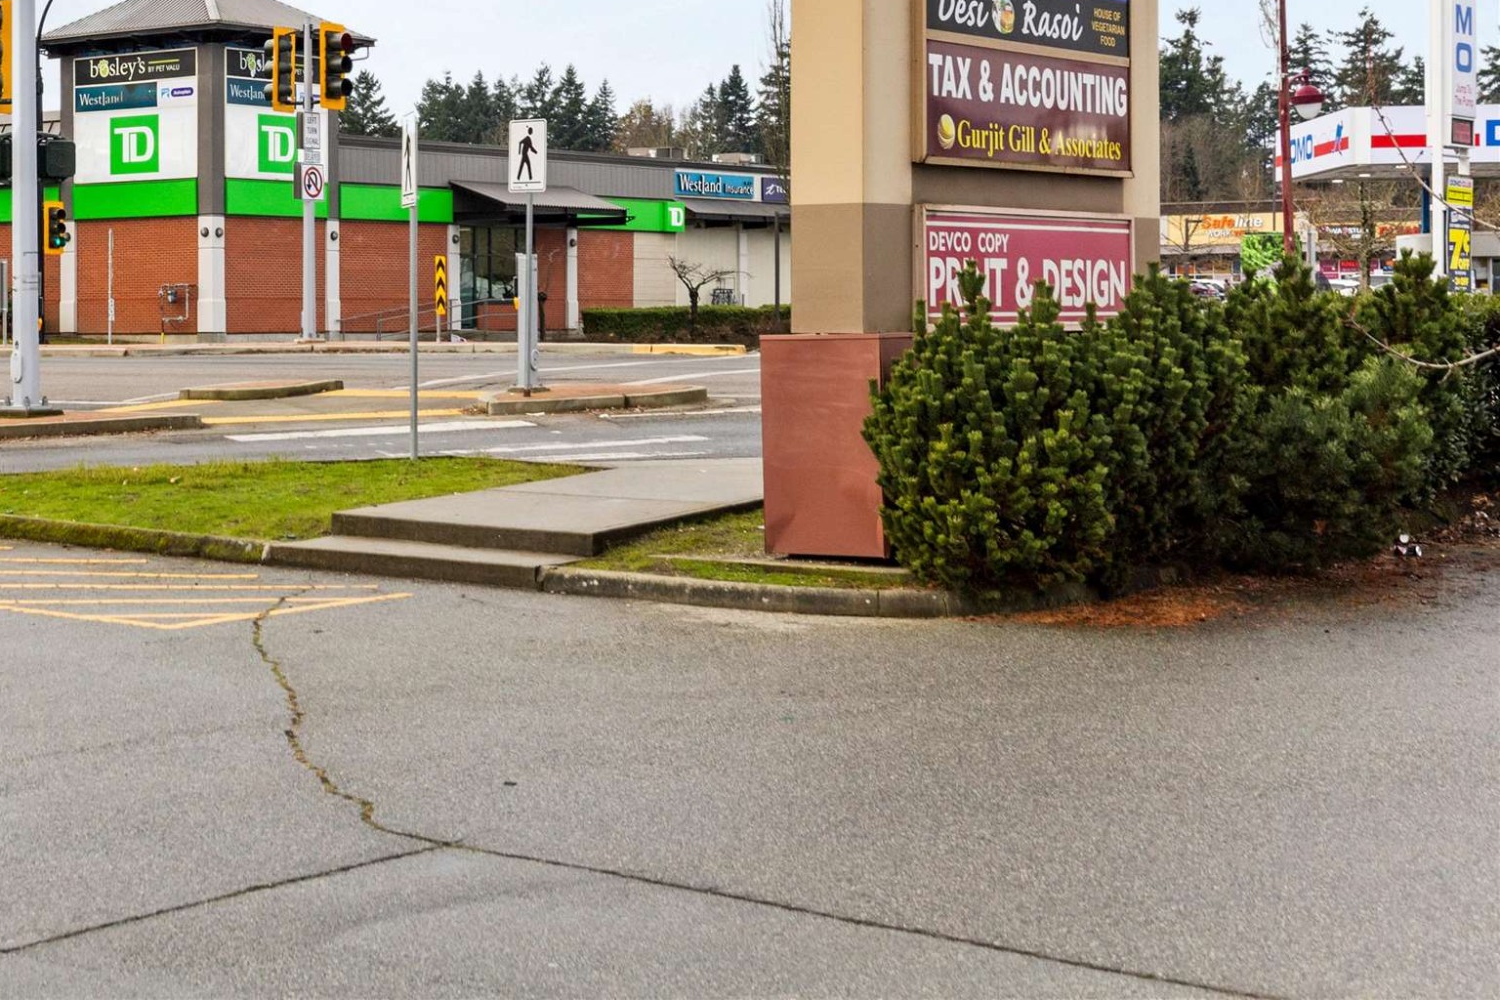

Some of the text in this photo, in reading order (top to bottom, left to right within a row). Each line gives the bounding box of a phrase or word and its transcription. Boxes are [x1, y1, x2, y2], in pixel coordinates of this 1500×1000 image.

[1021, 0, 1084, 42] Rasoi
[1093, 7, 1121, 21] HOUSE OF
[1091, 20, 1125, 36] VEGETARIAN
[1100, 36, 1116, 47] FOOD
[90, 57, 145, 80] bosley's
[230, 84, 266, 100] Westlan
[928, 53, 1127, 117] TAX & ACCOUNTING
[79, 91, 123, 106] Westland
[114, 126, 155, 163] TD
[261, 125, 295, 162] TD
[957, 119, 1121, 161] Gurjit Gill & Associates
[1290, 134, 1313, 163] OMO
[679, 174, 721, 194] Westland
[668, 207, 684, 226] TD
[929, 231, 1010, 253] DEVCO COPY
[1015, 256, 1034, 308] &
[1042, 258, 1126, 308] DESIGN
